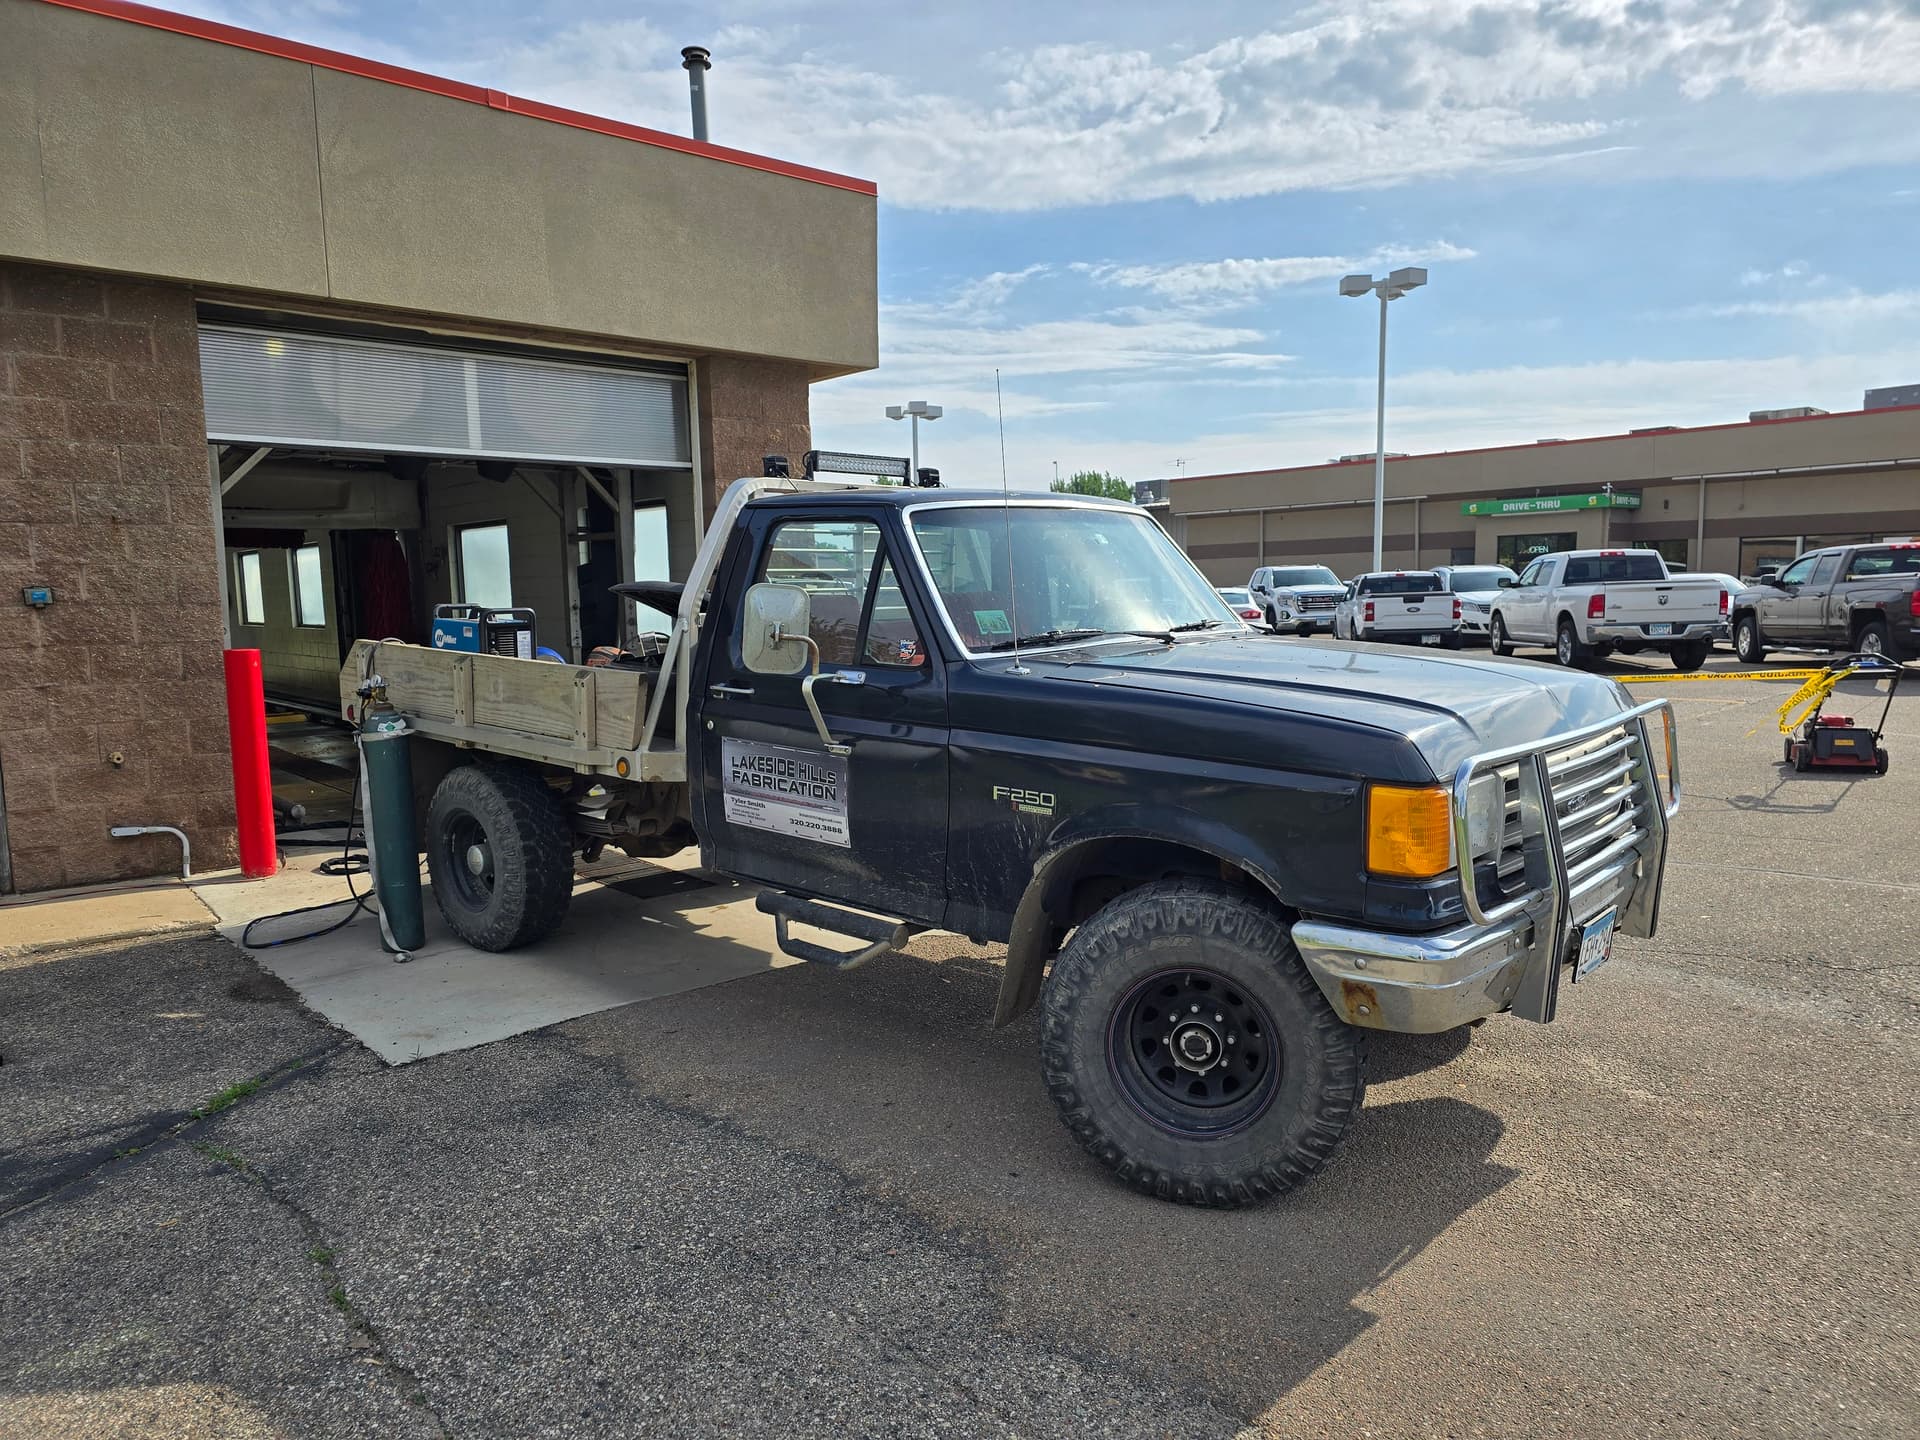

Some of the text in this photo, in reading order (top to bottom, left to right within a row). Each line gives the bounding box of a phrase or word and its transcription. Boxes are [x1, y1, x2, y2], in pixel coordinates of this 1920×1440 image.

[1503, 499, 1561, 511] DRIVE-THRU
[1529, 545, 1549, 554] OPEN
[731, 756, 836, 785] LAKESIDE HILLS
[732, 769, 836, 800] FABRICATION
[747, 800, 766, 809] Smith
